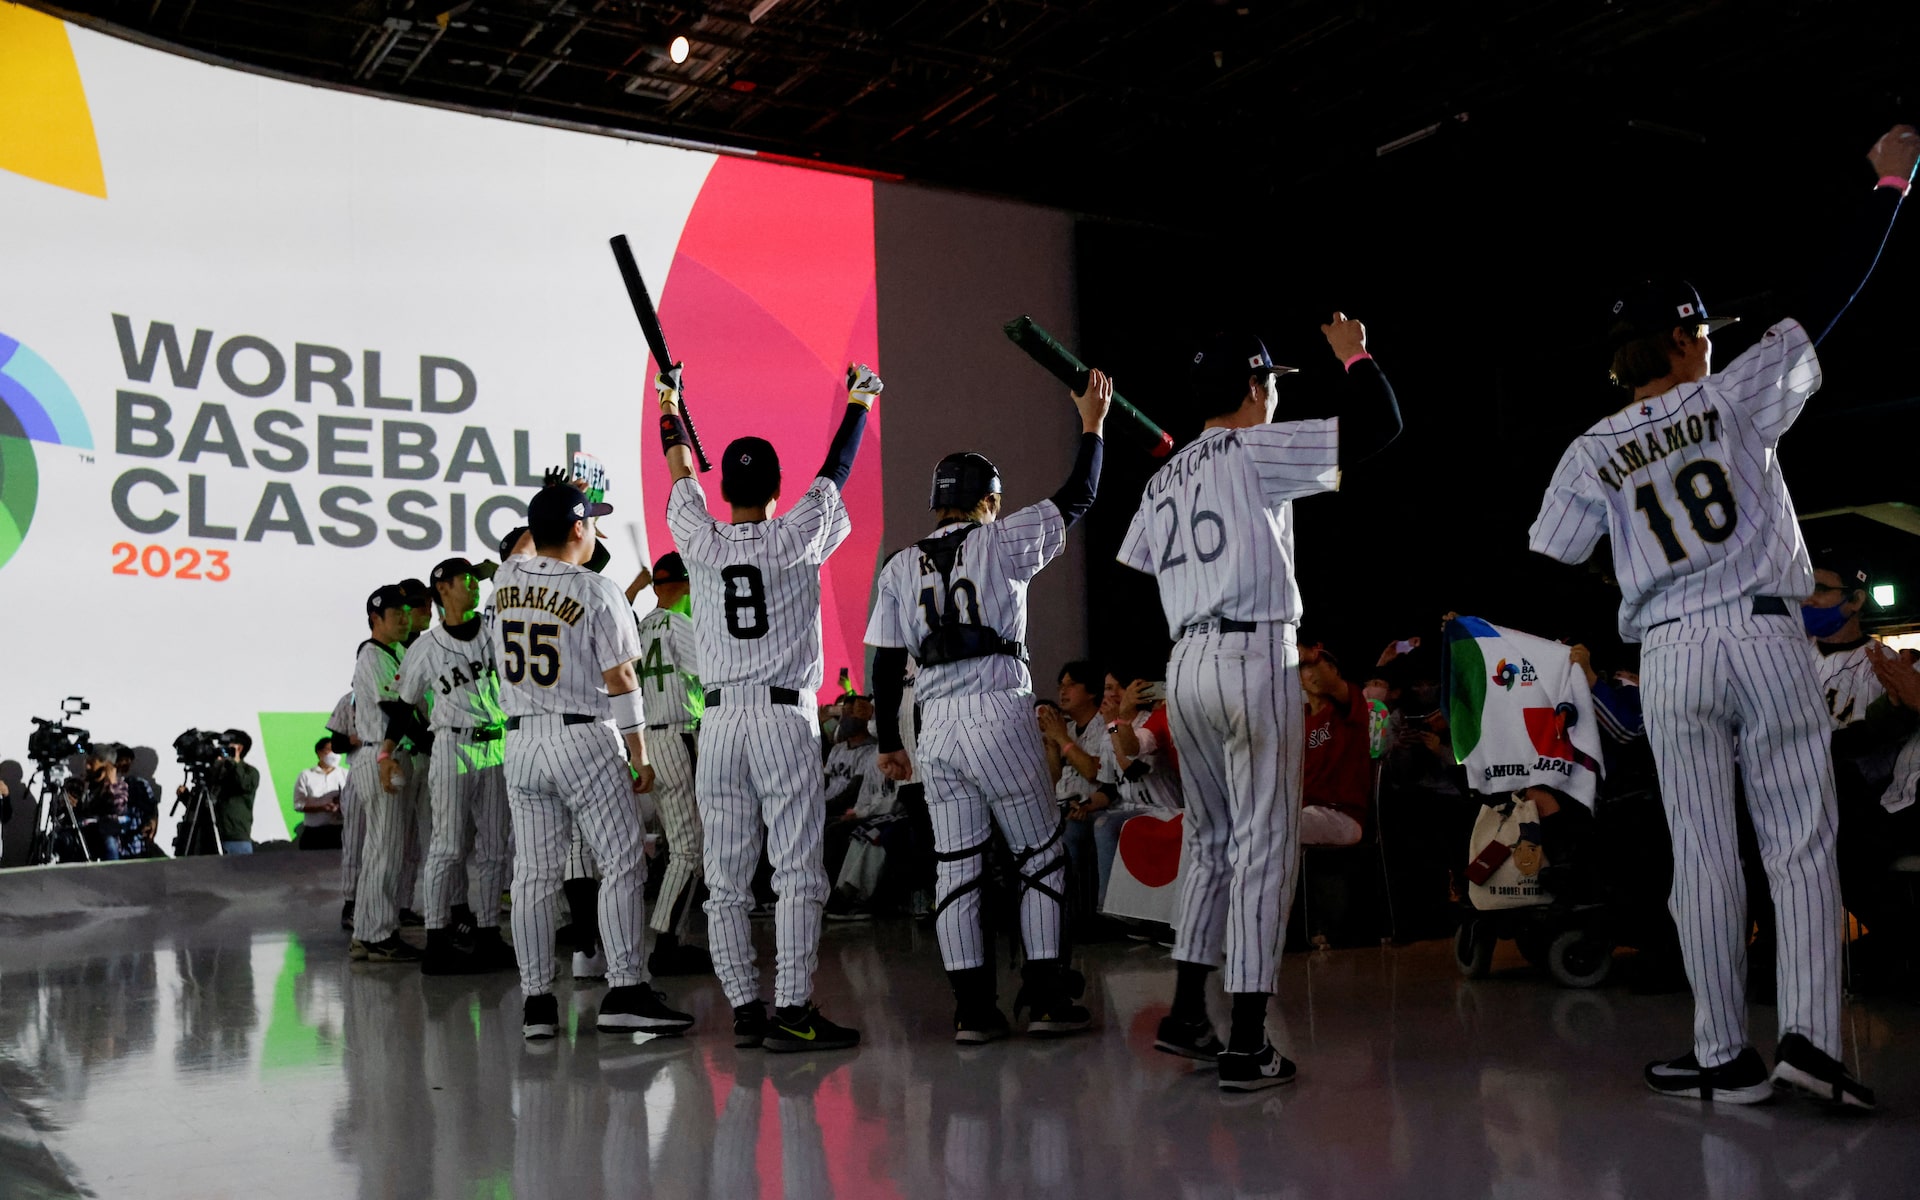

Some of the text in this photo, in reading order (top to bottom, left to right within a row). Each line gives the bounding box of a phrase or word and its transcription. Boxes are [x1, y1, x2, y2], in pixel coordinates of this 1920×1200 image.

[111, 312, 478, 415] WORLD
[115, 389, 610, 491] BASEBALL
[1598, 410, 1719, 492] YAMAMOT
[111, 467, 532, 552] CLASSIC
[1155, 483, 1227, 573] 26
[1635, 458, 1738, 565] 18
[112, 542, 232, 582] 2023
[919, 545, 964, 576] KI
[721, 564, 770, 640] 8
[439, 658, 494, 695] JAP
[502, 619, 561, 688] 55
